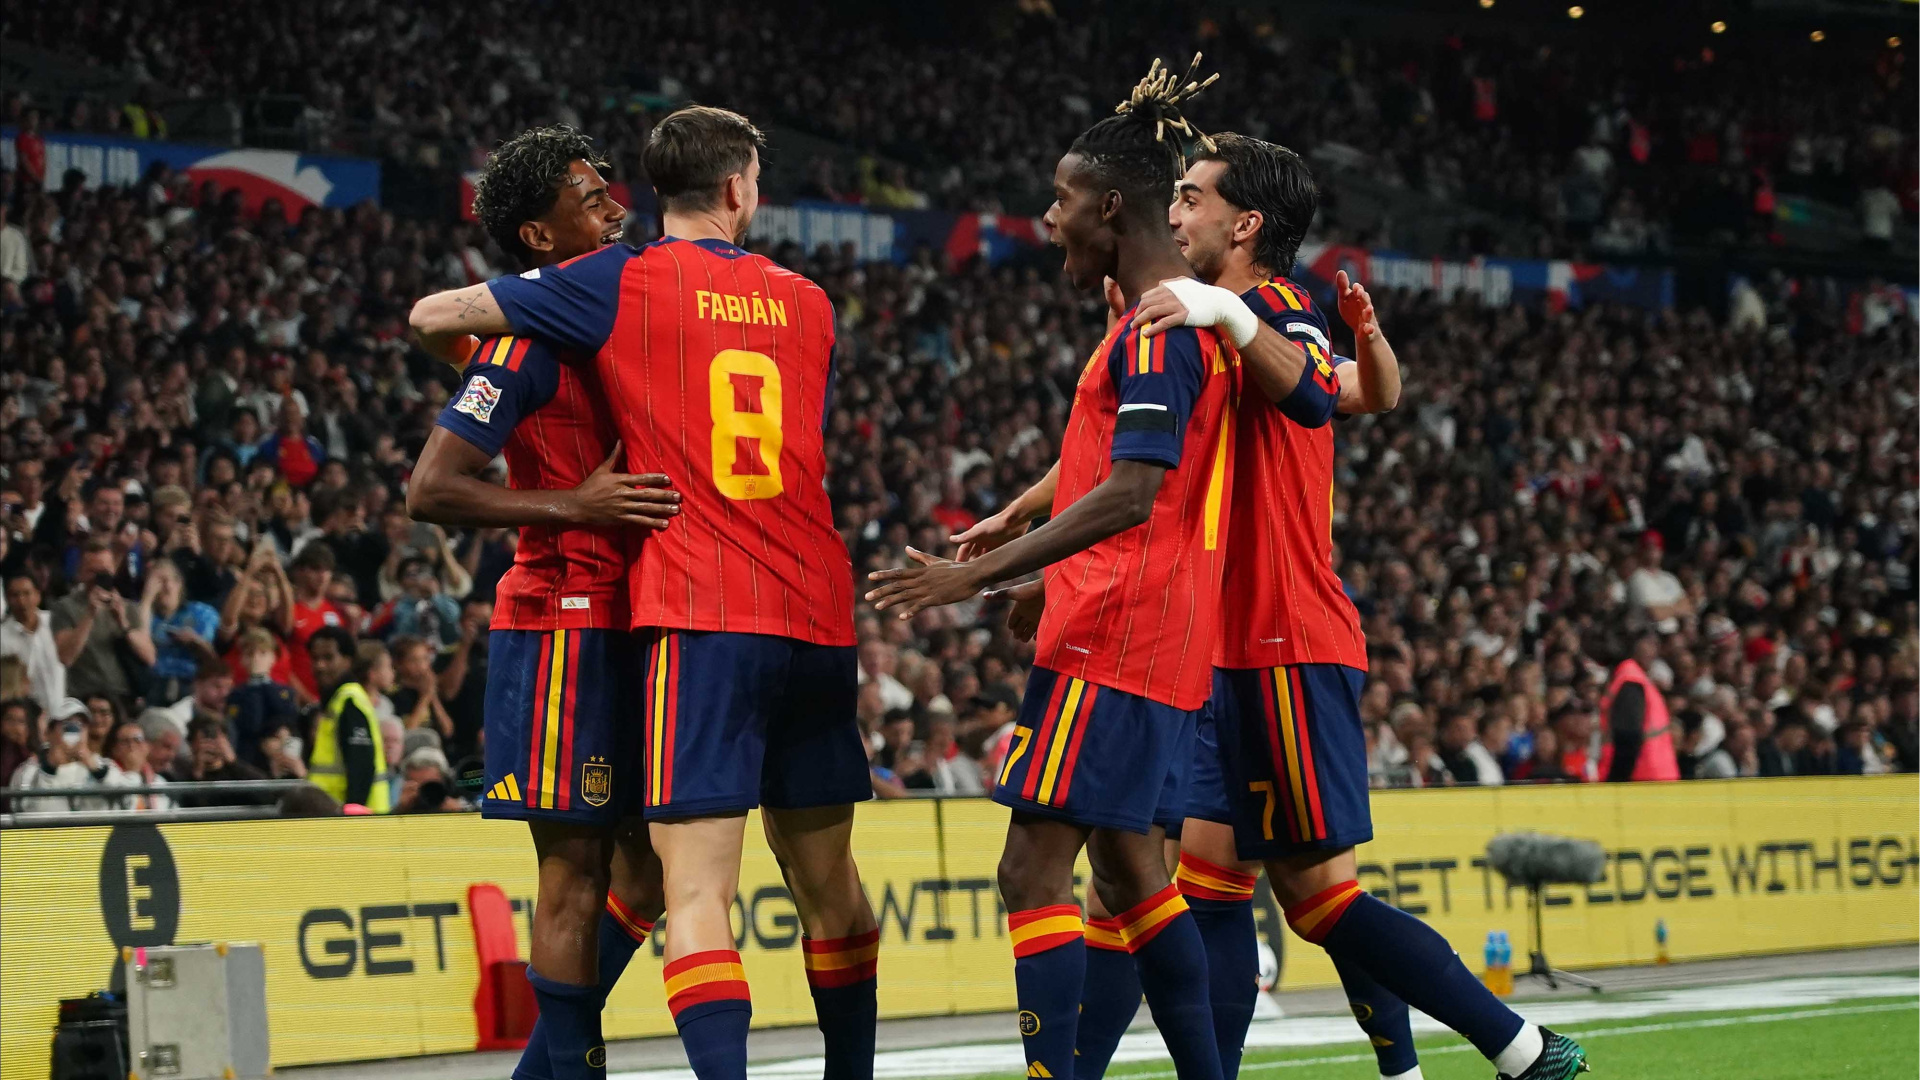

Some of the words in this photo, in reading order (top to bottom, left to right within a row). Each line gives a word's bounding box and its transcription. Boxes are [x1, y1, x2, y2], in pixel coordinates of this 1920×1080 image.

[695, 290, 788, 327] FABIÁN
[709, 348, 783, 500] 8
[1000, 725, 1033, 786] 7
[1250, 781, 1275, 840] 7
[125, 855, 155, 931] E
[1722, 837, 1842, 895] WITH
[299, 901, 458, 979] GET
